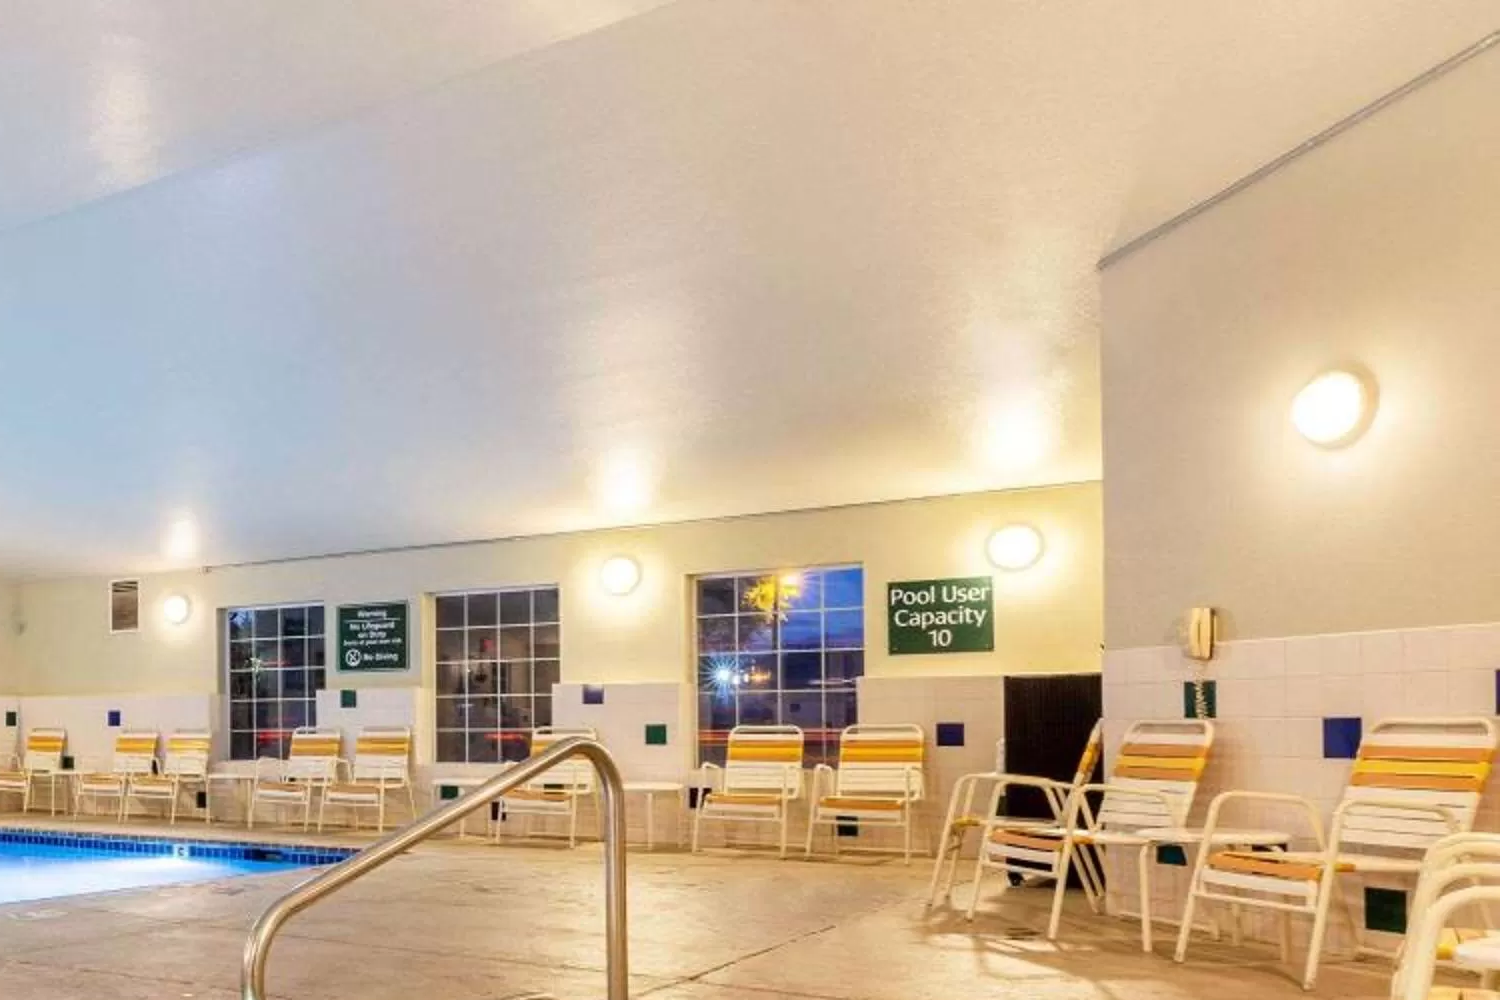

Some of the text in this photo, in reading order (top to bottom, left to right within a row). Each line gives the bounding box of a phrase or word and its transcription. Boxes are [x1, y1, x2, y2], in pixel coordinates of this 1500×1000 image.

[890, 585, 991, 606] Pool User
[894, 605, 988, 630] Capacity
[927, 629, 953, 647] 10
[375, 652, 399, 662] Diving
